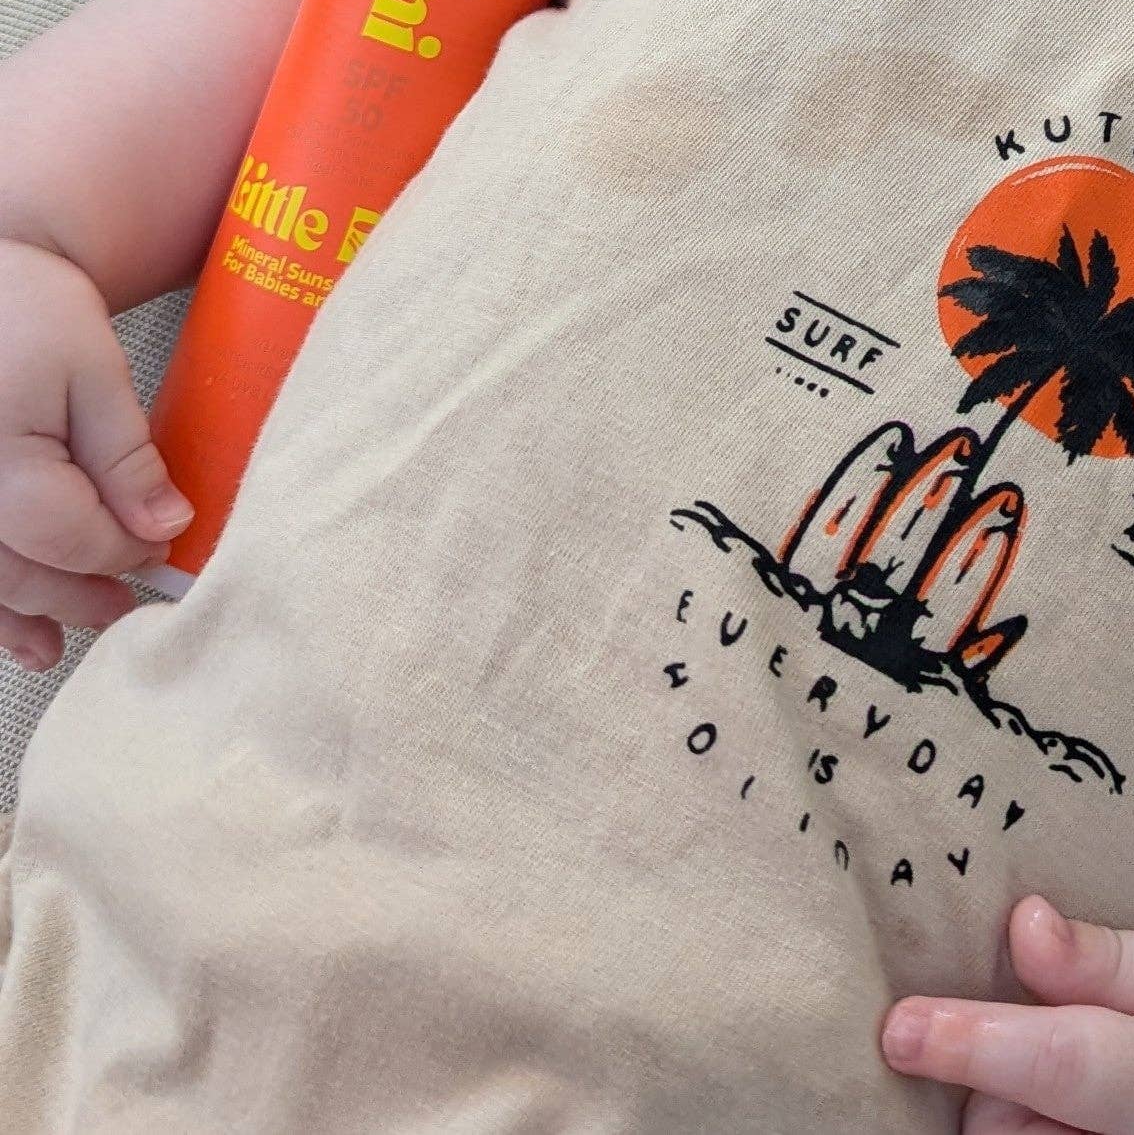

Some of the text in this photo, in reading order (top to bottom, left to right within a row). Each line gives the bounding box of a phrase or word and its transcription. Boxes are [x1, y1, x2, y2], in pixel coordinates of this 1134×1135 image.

[223, 250, 246, 275] For
[245, 263, 300, 301] Babies
[231, 234, 287, 274] Mineral
[775, 307, 884, 371] SURF
[808, 749, 839, 784] IS
